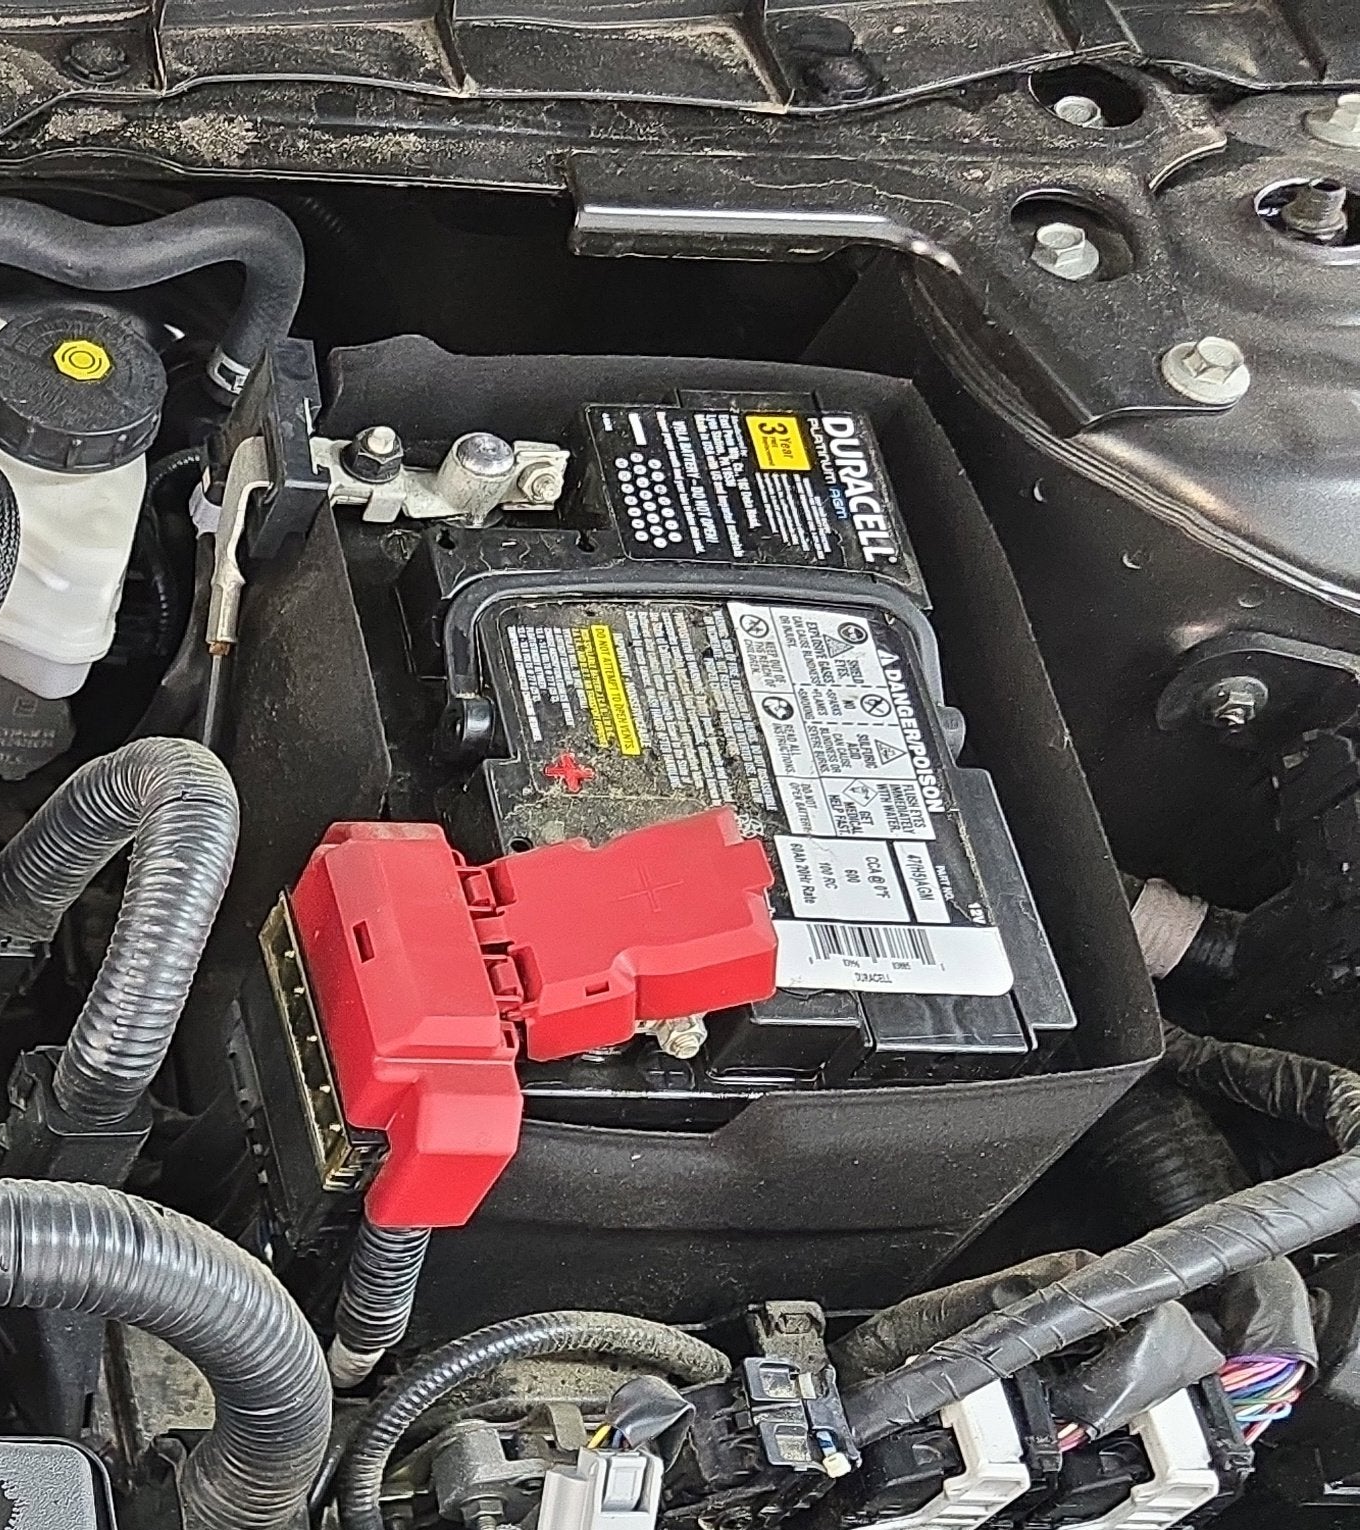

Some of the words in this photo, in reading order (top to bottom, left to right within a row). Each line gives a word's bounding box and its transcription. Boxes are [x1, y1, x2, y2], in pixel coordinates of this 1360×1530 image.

[756, 422, 789, 435] 3
[777, 437, 796, 458] Year
[806, 417, 838, 484] PLATINUM
[678, 442, 700, 478] BATTERY
[690, 486, 706, 499] DO
[820, 416, 898, 563] DURACELL
[694, 499, 711, 517] NOT
[593, 628, 606, 638] DO
[596, 640, 610, 654] NOT
[611, 632, 633, 677] IMPORTANT
[804, 621, 827, 659] EXPLOSIVE
[816, 660, 835, 683] GASES
[601, 657, 619, 690] ATTEMPT
[768, 659, 783, 672] OUT
[846, 659, 864, 683] SHIELD
[763, 678, 776, 687] OF
[773, 674, 786, 683] OF
[610, 692, 623, 702] TO
[842, 700, 856, 709] NO
[613, 704, 628, 723] OPEN
[782, 724, 798, 742] READ
[831, 733, 845, 746] CAN
[883, 669, 946, 812] DANGER/POISON
[788, 743, 802, 756] ALL
[835, 748, 852, 768] CAUSE
[846, 742, 862, 759] ACID
[829, 764, 841, 772] OR
[827, 794, 844, 813] HELP
[901, 784, 920, 807] FLUSH
[842, 801, 863, 834] MEDICAL
[858, 810, 874, 825] GET
[881, 804, 901, 832] WATER.
[888, 784, 915, 834] IMMEDIATELY
[909, 809, 926, 827] EYES
[833, 814, 851, 835] FAST.
[794, 864, 813, 883] 20Hr
[863, 856, 882, 873] CCA
[822, 876, 838, 889] RC
[934, 865, 950, 884] PART
[800, 885, 819, 904] Rate
[966, 902, 986, 924] 12V
